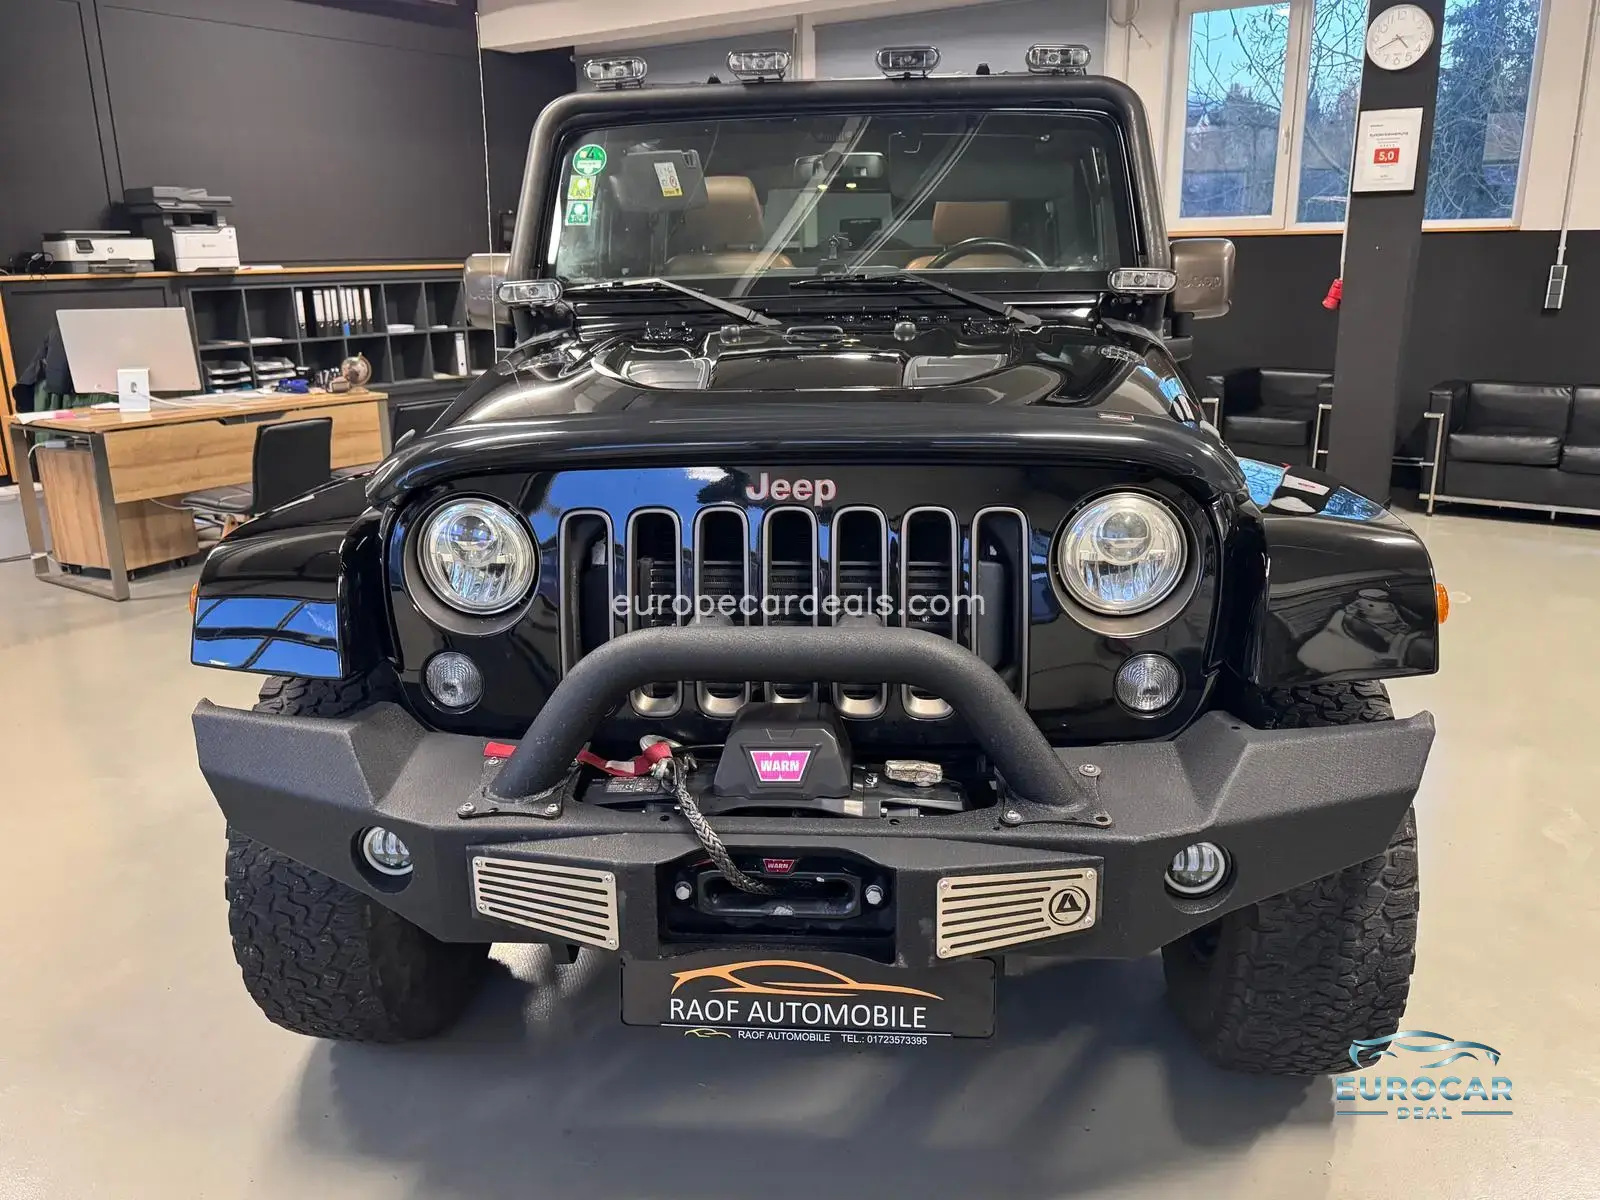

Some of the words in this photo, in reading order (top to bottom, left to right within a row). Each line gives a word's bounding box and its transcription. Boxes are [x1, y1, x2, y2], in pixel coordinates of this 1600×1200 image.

[1379, 151, 1395, 162] 5,0
[745, 472, 837, 507] Jeep
[760, 759, 800, 772] WARN
[670, 998, 740, 1022] RAOF
[747, 1000, 927, 1029] AUTOMOBILE
[737, 1030, 765, 1040] RAOF
[766, 1031, 831, 1042] AUTOMOBILE
[841, 1033, 865, 1044] TEL.:
[867, 1034, 928, 1045] 01723573395
